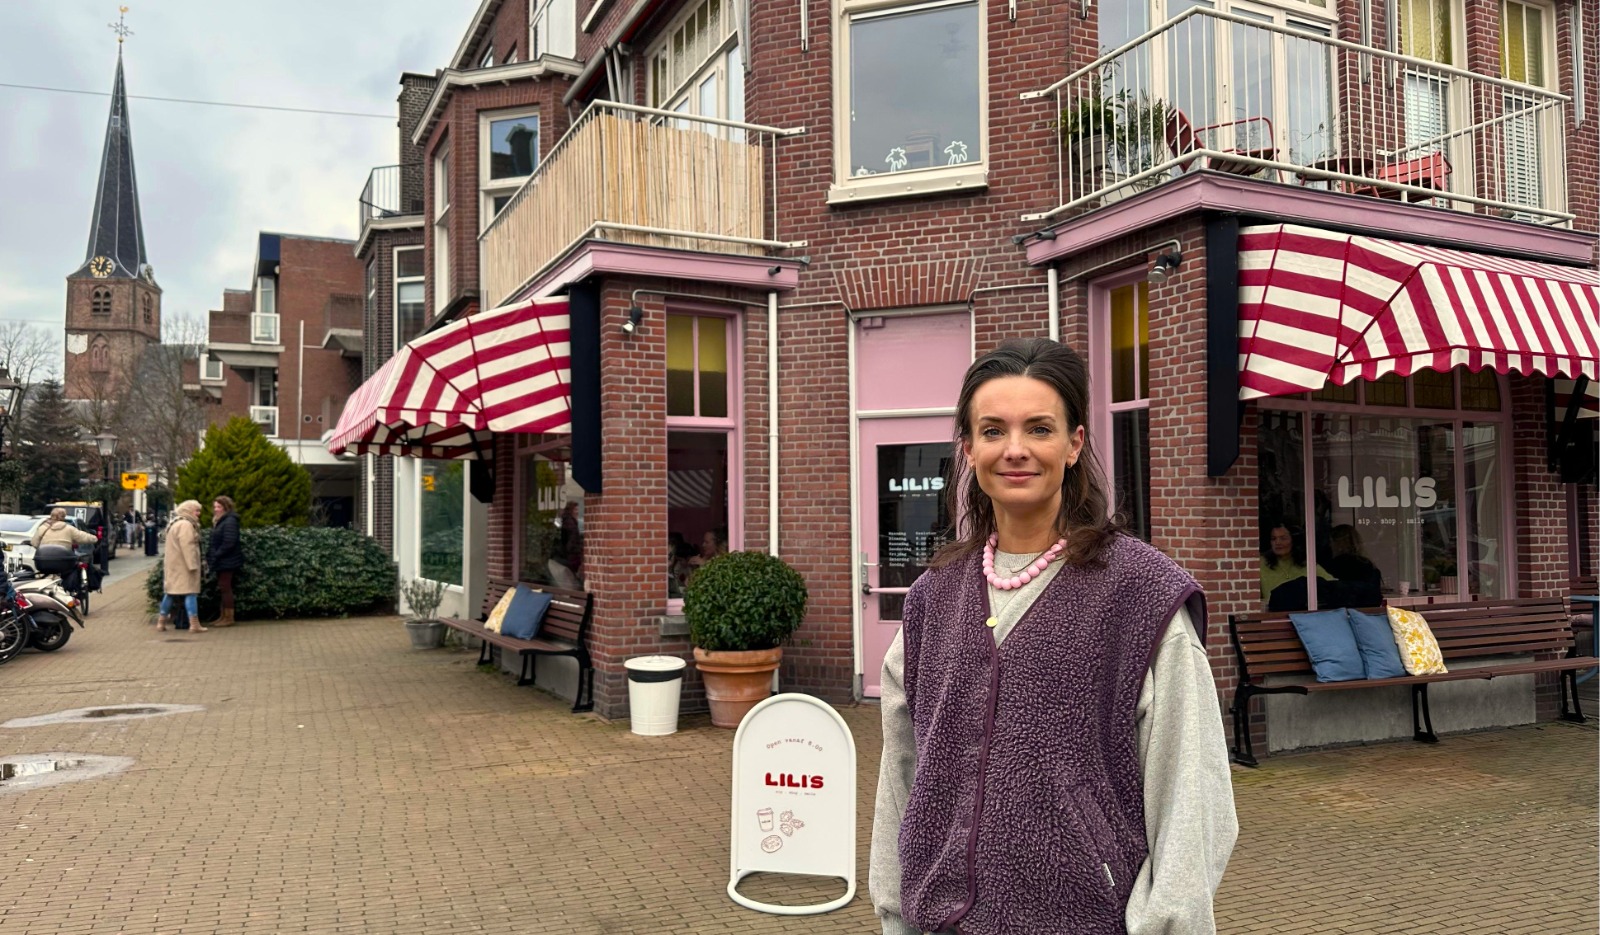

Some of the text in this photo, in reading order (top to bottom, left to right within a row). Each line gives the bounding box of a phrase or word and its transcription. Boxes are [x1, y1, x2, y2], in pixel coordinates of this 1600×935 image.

[889, 476, 944, 491] LILI'S
[1338, 475, 1437, 508] LILI'S
[1358, 518, 1371, 526] sip
[1381, 518, 1396, 526] shop
[766, 740, 781, 749] Open
[765, 772, 824, 789] LILI'S
